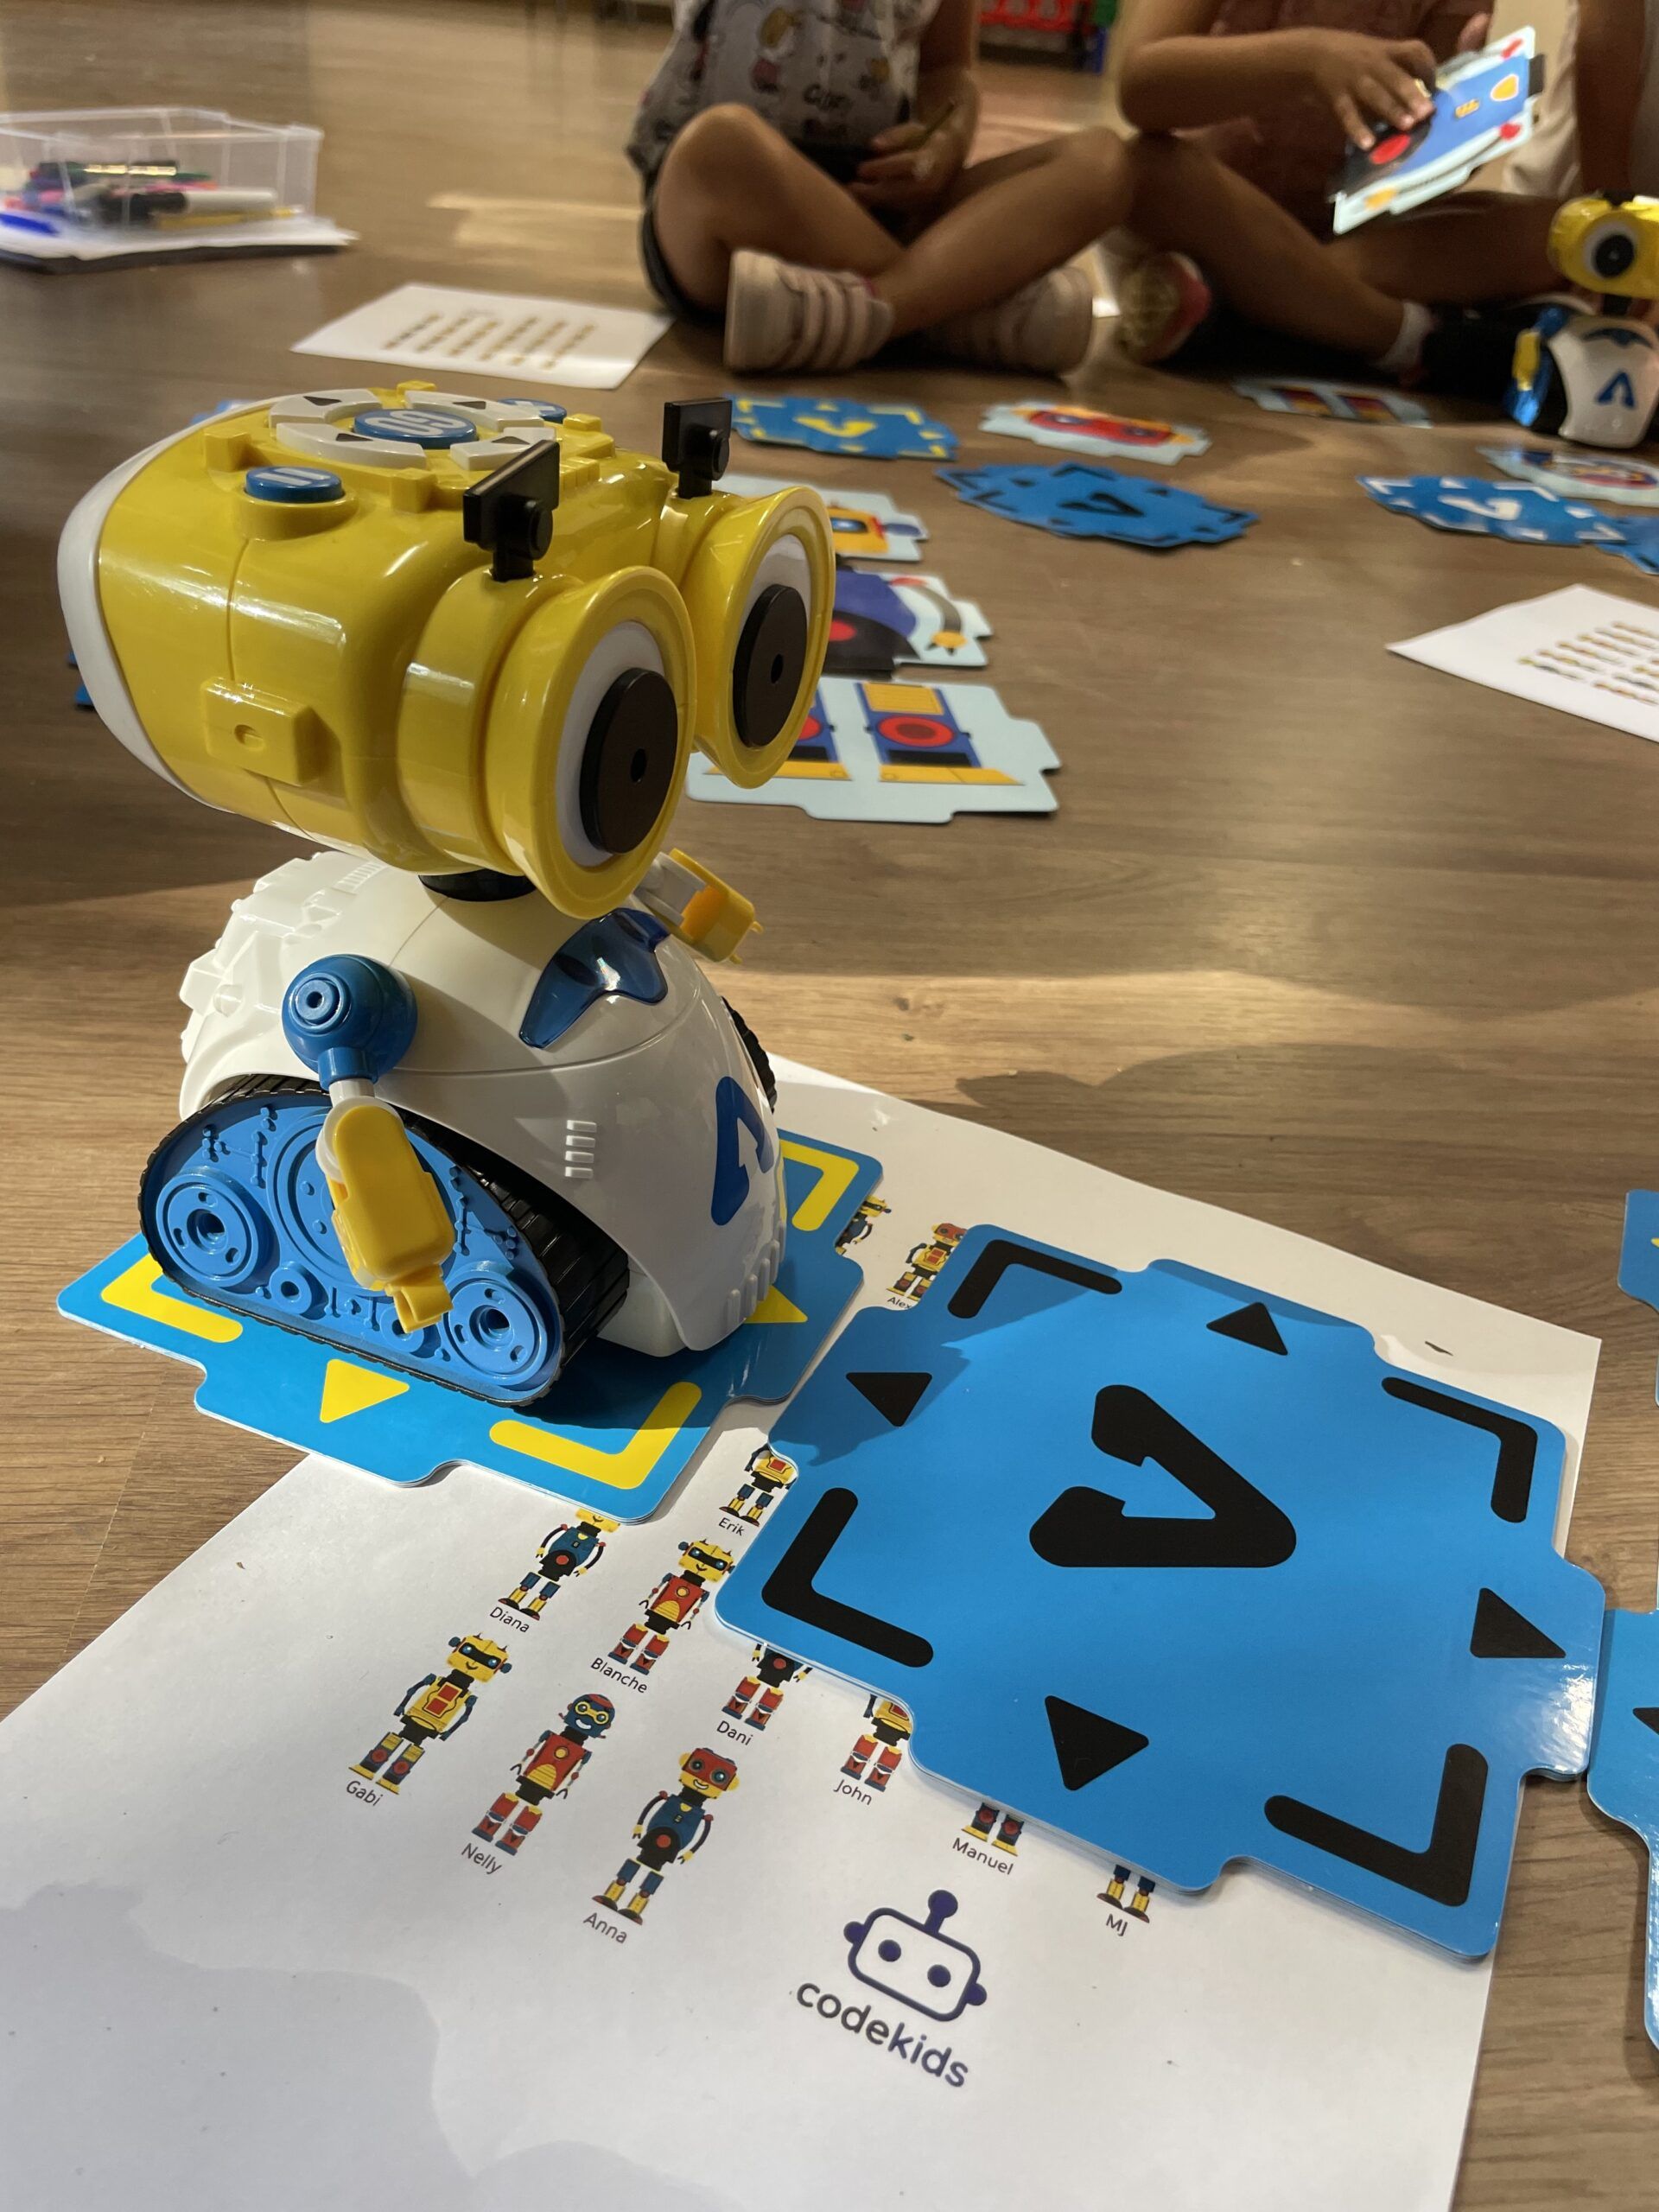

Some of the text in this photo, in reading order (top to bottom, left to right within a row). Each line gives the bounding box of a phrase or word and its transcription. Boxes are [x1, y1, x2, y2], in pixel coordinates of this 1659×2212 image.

[365, 410, 467, 436] GO
[887, 1296, 912, 1309] Alex
[719, 1517, 744, 1535] Erik
[490, 1607, 529, 1632] Diana
[591, 1658, 647, 1693] Blanche
[717, 1720, 753, 1745] Dani
[346, 1781, 383, 1806] Gabi
[834, 1780, 871, 1805] John
[461, 1843, 502, 1874] Nelly
[953, 1838, 1014, 1874] Manuel
[583, 1913, 626, 1943] Anna
[1106, 1914, 1128, 1936] MJ
[798, 1983, 968, 2087] codekids
